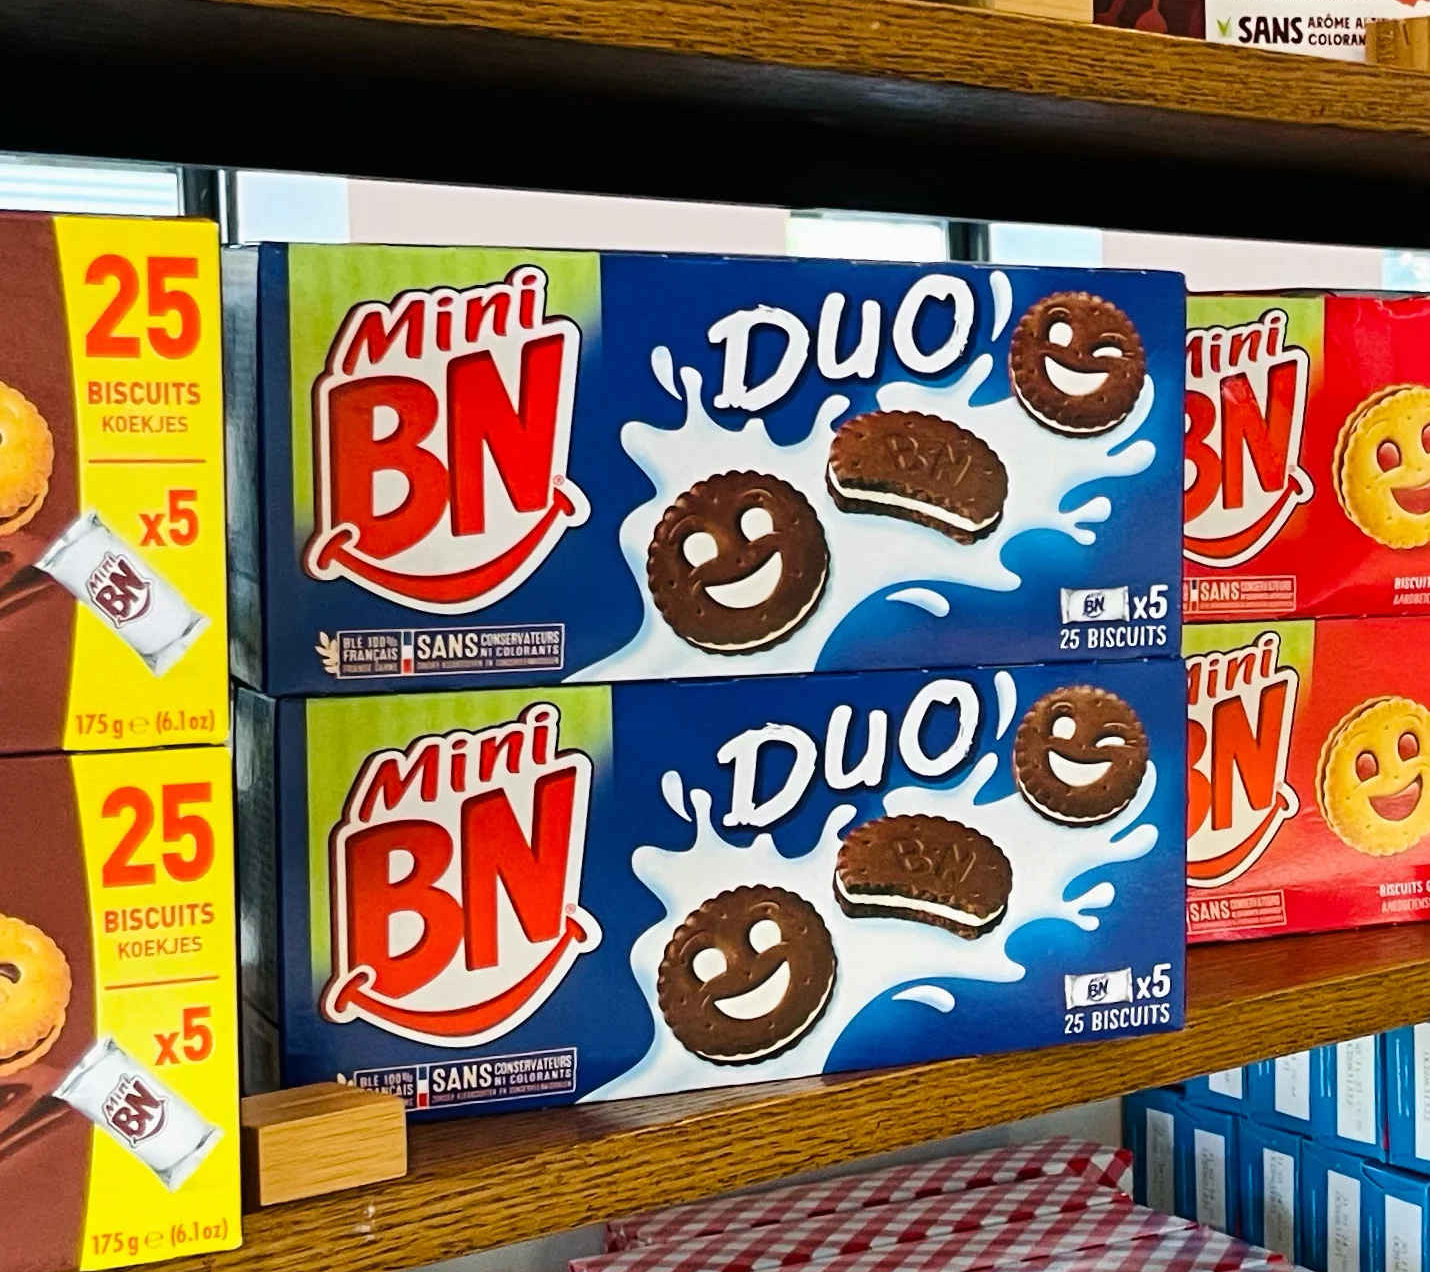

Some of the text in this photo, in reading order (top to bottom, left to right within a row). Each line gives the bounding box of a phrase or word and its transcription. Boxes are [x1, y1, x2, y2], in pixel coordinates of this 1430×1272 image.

[1238, 15, 1351, 46] SANS ARÔME
[85, 254, 202, 361] 25
[343, 274, 542, 376] Mini
[706, 274, 977, 413] DUO
[87, 380, 202, 407] BISCUITS
[102, 414, 189, 435] KOEKJES
[328, 333, 566, 559] BN
[139, 489, 200, 549] x5
[1132, 585, 1168, 621] x5
[1200, 581, 1241, 601] SANS
[343, 646, 399, 664] FRANÇAIS
[417, 630, 560, 660] SANS CONSERVATEURS
[495, 644, 560, 658] COLORANTS
[1059, 625, 1168, 650] 25 BISCUITS
[359, 710, 555, 824] Mini
[716, 677, 980, 829] DUO
[101, 780, 216, 889] 25
[345, 767, 577, 999] BN
[103, 903, 216, 934] BISCUITS
[1136, 963, 1172, 1000] x5
[153, 1005, 214, 1068] x5
[1063, 1003, 1171, 1035] 25 BISCUITS
